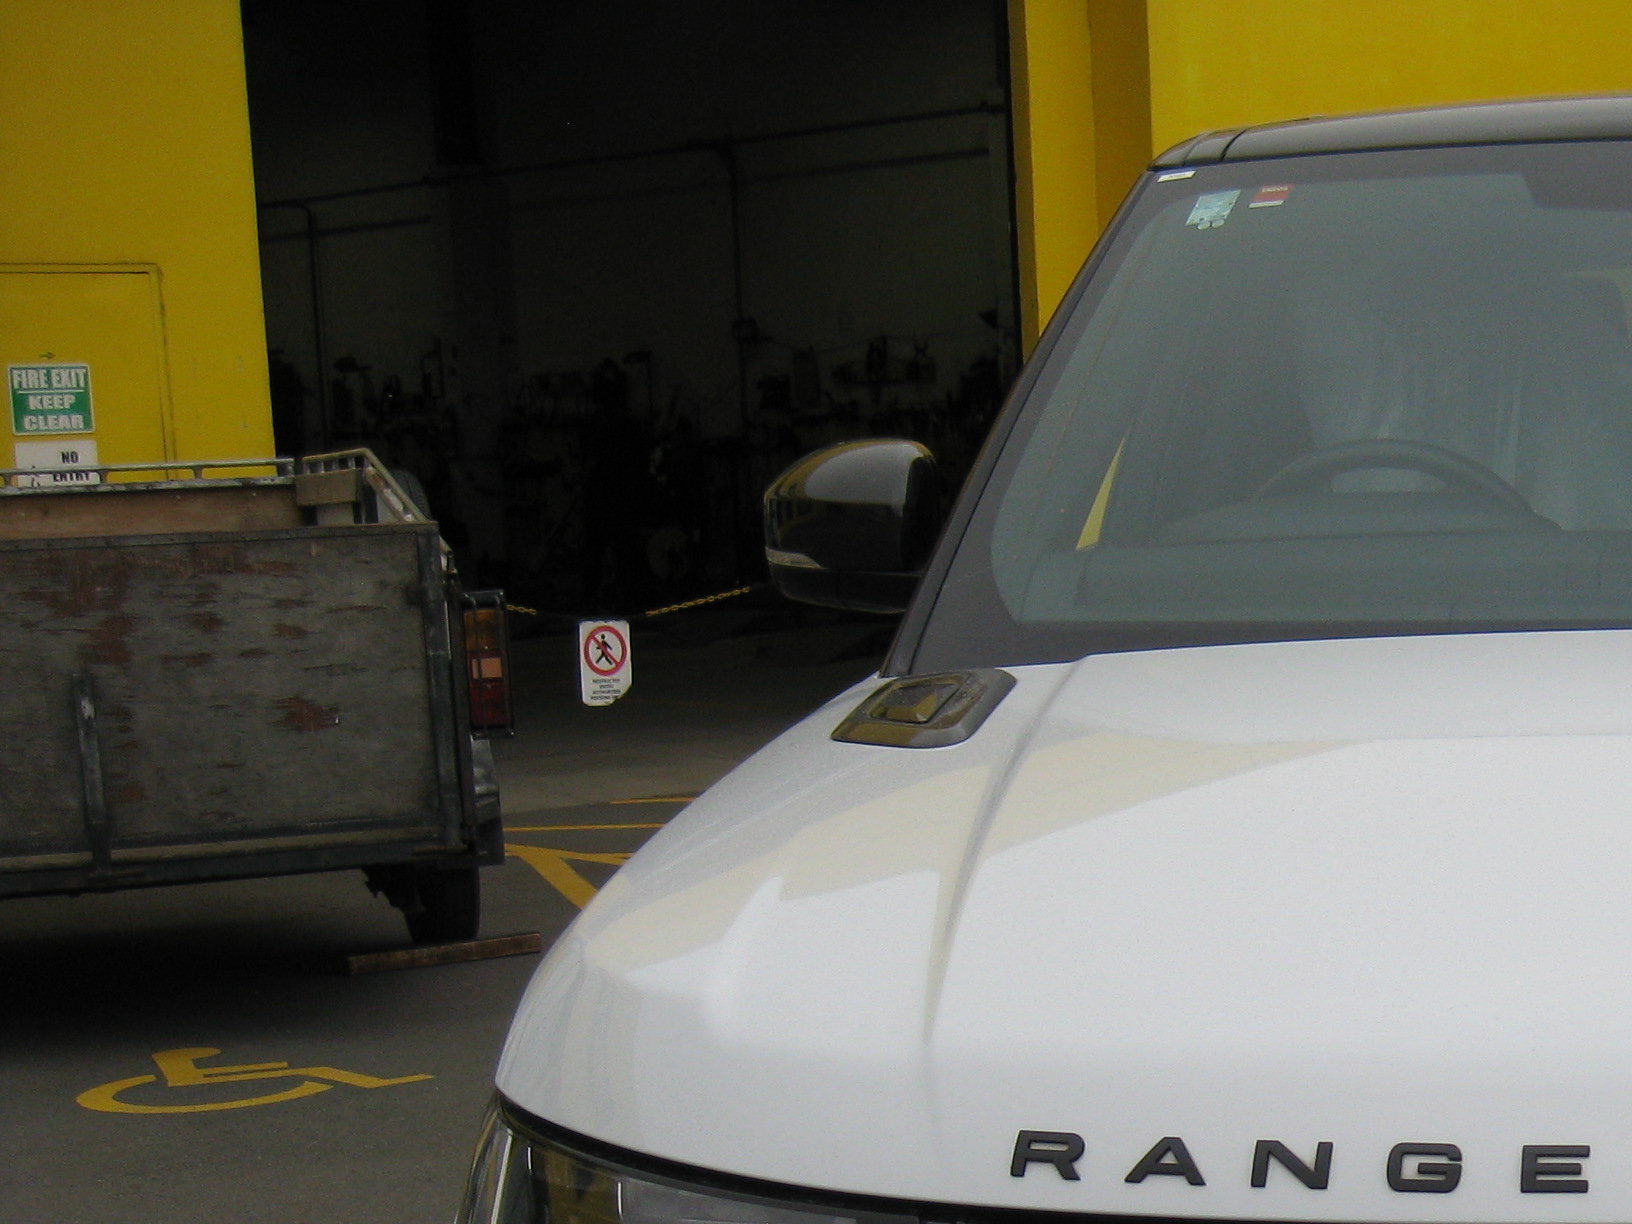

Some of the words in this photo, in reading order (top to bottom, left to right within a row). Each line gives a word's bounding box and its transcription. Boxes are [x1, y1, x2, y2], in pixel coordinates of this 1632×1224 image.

[11, 369, 49, 389] FIRE
[50, 368, 87, 388] EXIT
[27, 394, 76, 410] KEEP
[24, 414, 84, 430] CLEAR
[61, 451, 79, 464] NO
[1010, 1130, 1590, 1193] RANGE
